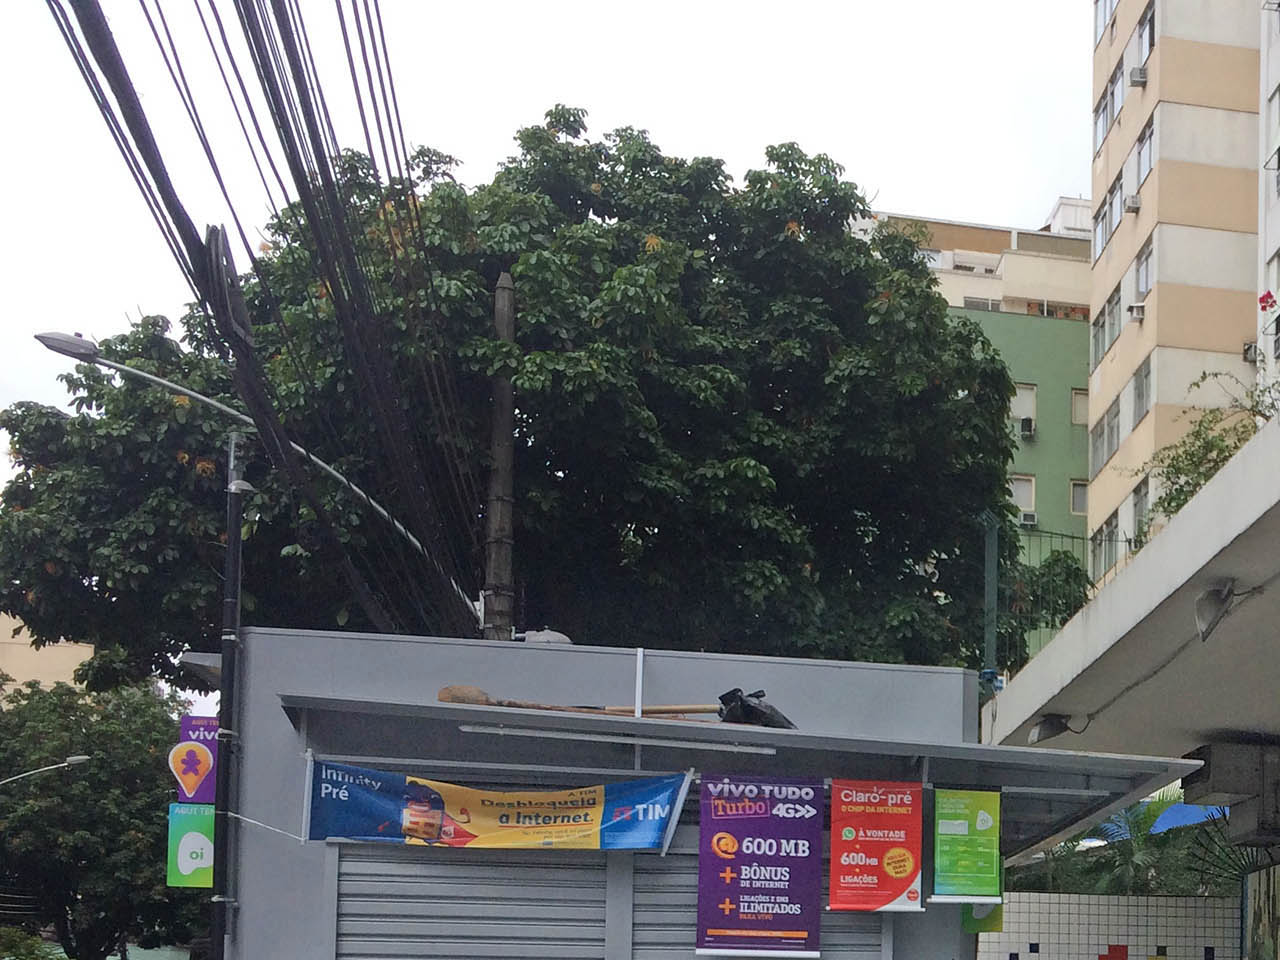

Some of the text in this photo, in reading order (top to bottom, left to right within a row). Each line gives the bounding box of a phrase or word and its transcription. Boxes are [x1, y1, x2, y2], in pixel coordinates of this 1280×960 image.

[321, 784, 349, 800] Pré
[761, 785, 815, 801] TUDO
[634, 804, 670, 820] TIM
[714, 798, 766, 816] Turbo
[866, 829, 906, 838] VONTADE
[742, 837, 778, 856] 600
[779, 840, 811, 857] MB
[841, 852, 866, 866] 600
[740, 863, 790, 881] BÔNUS
[840, 874, 878, 885] LIGAÇÕES
[752, 881, 790, 889] INTERNET
[740, 903, 802, 915] ILIMITADOS
